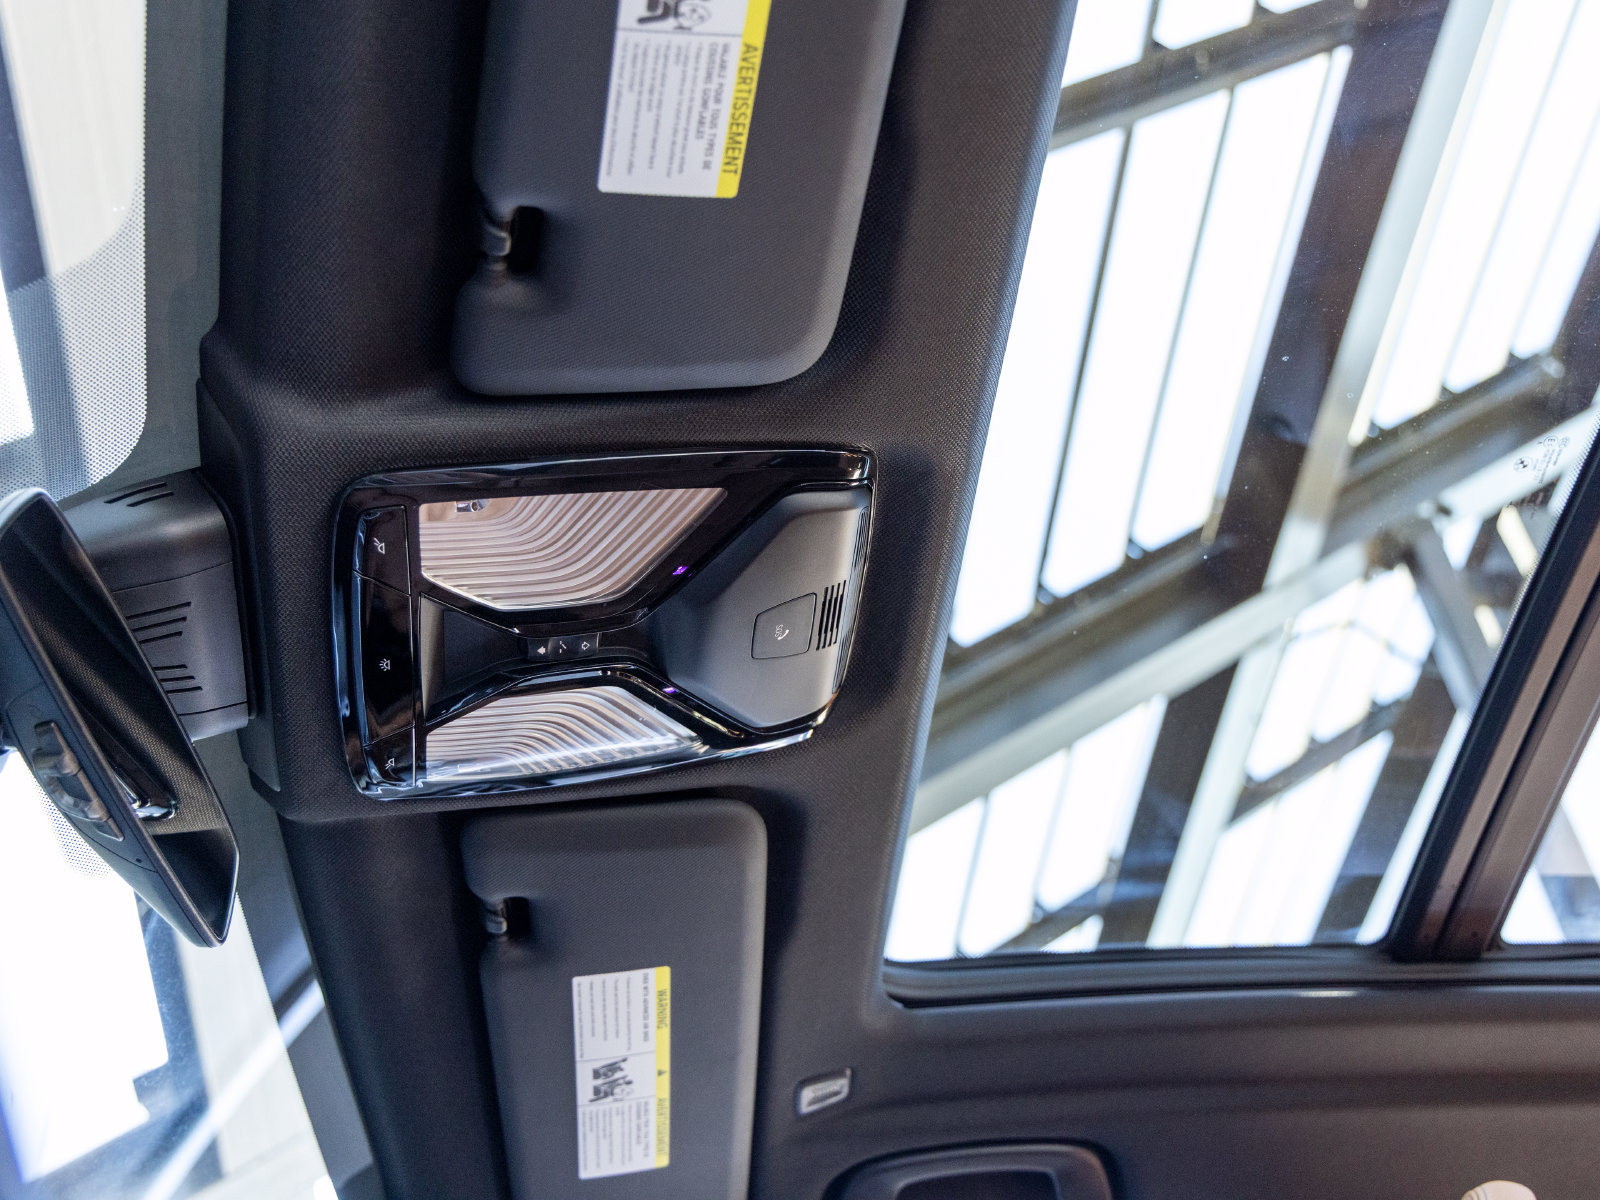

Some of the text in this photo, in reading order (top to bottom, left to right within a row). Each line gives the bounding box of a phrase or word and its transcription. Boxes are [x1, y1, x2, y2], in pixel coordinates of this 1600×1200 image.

[713, 82, 724, 103] POUR
[709, 108, 720, 129] TOUS
[722, 42, 758, 175] AVERTISSEMENT
[704, 133, 716, 157] TYPES
[774, 624, 784, 638] SOS
[656, 988, 667, 1029] WARNING
